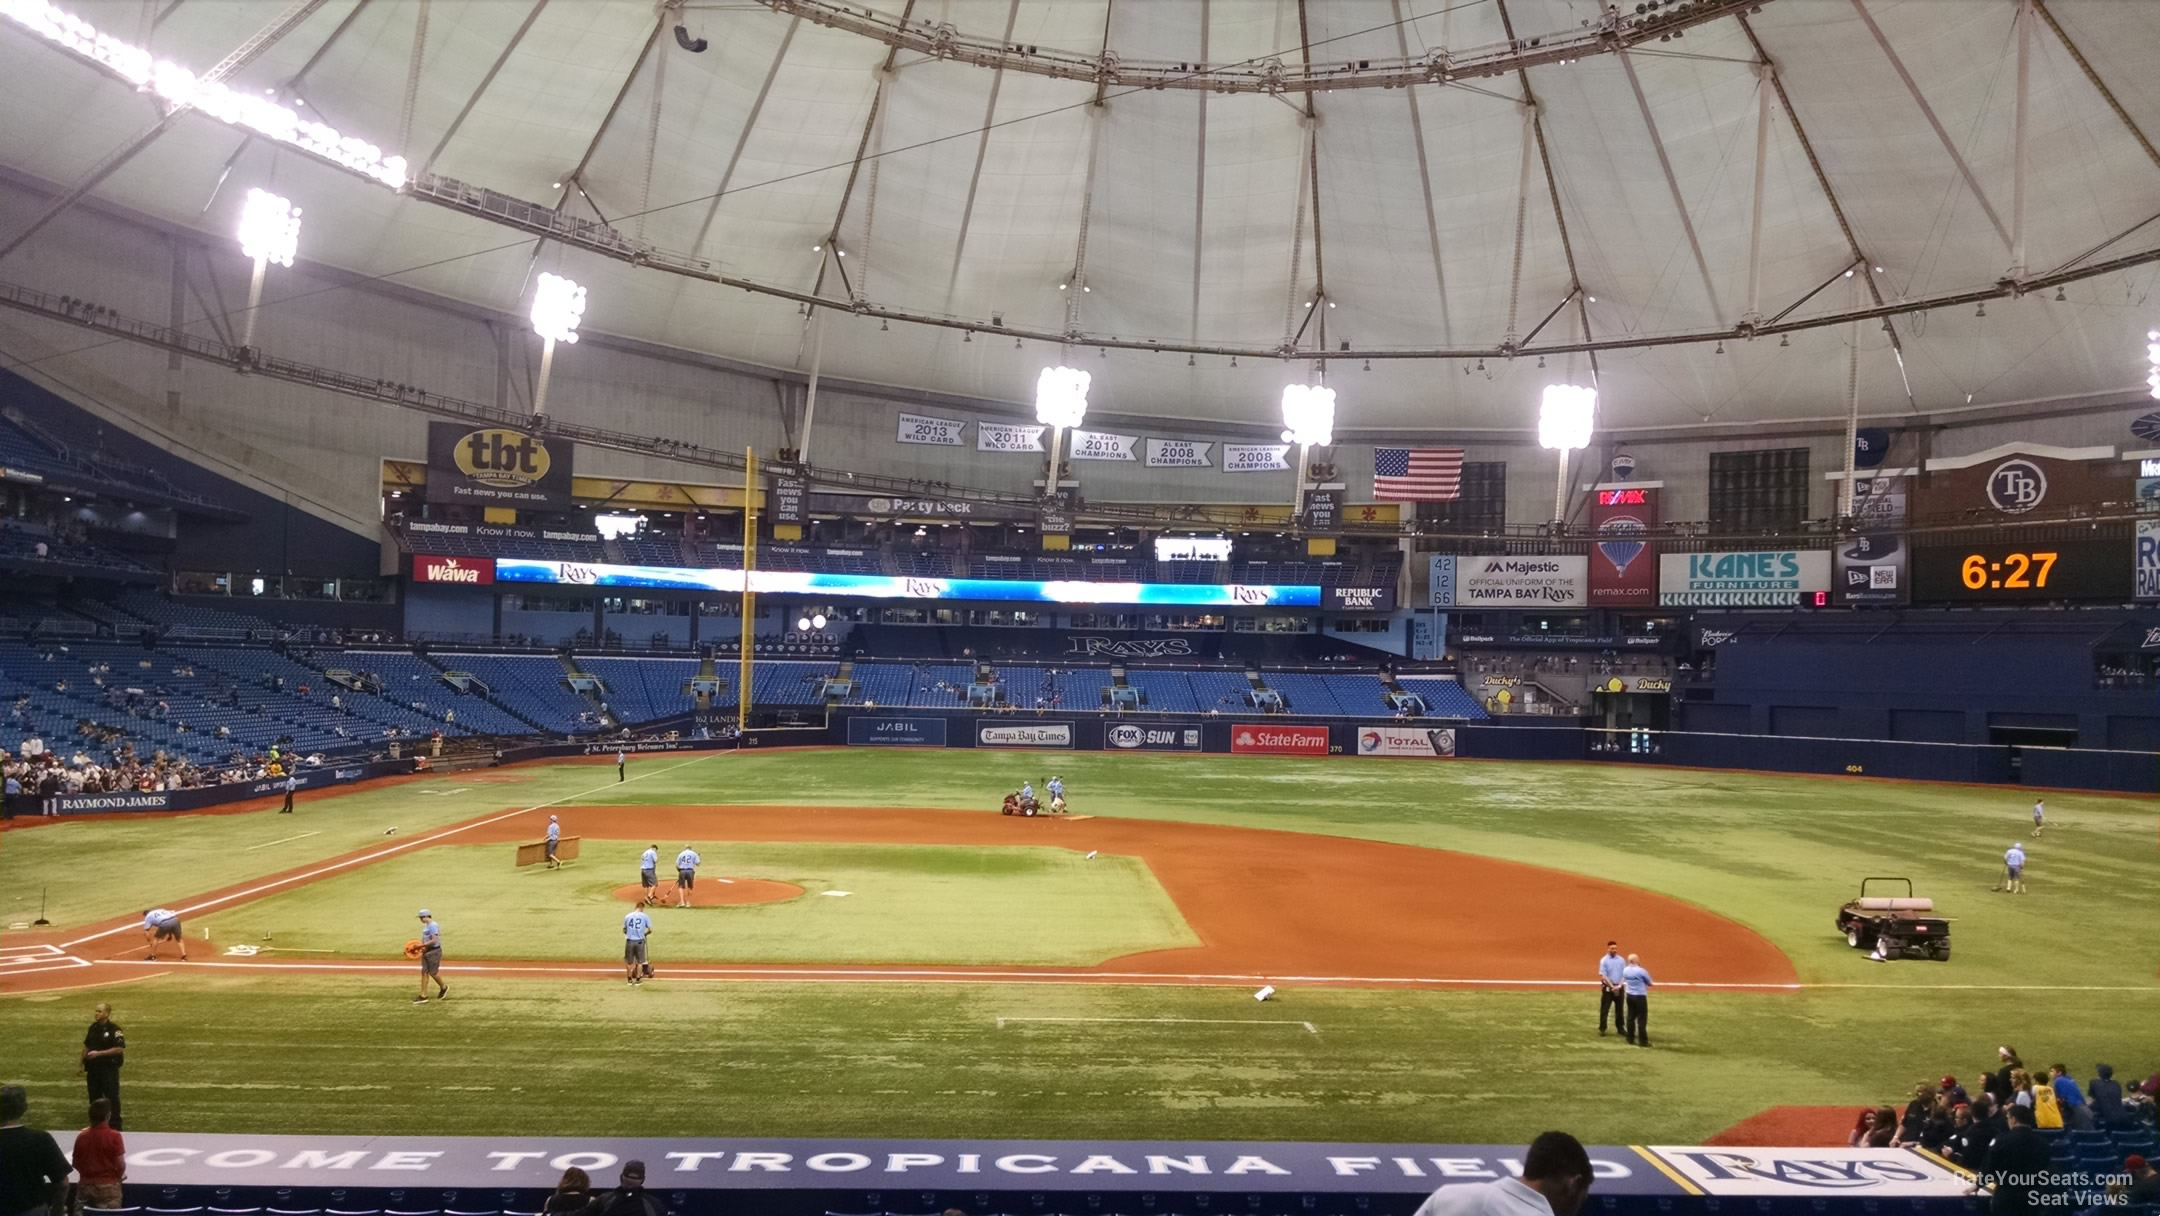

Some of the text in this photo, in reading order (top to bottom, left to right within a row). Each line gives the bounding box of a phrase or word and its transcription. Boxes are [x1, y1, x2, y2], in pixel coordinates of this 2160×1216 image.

[901, 417, 934, 425] AMERICAN
[915, 424, 948, 437] 2013
[905, 433, 954, 444] WILD CARD
[994, 432, 1026, 443] 2011
[1010, 442, 1034, 450] CARD
[1085, 440, 1120, 452] 2010
[1856, 437, 1869, 451] TB
[467, 433, 538, 474] tbt
[1075, 450, 1128, 459] CHAMPIONS
[1161, 448, 1194, 458] 2008
[1238, 452, 1273, 463] 2008
[1150, 457, 1203, 466] CHAMPIONS
[1228, 462, 1281, 470] CHAMPIONS
[776, 487, 802, 496] news
[1998, 470, 2037, 503] TB
[454, 486, 472, 495] Fast
[530, 493, 548, 501] use.
[780, 495, 799, 505] you
[780, 503, 798, 512] can
[779, 512, 799, 521] use.
[410, 522, 597, 542] tampabay.com Know it now. tampabay.com
[1041, 522, 1070, 532] buzz?
[1859, 537, 1870, 551] TB
[827, 548, 863, 556] tampabay.com
[1434, 559, 1451, 571] 42
[1506, 561, 1560, 575] Majestic
[1690, 553, 1799, 579] KANE'S
[427, 563, 477, 582] Wawa
[1962, 553, 2058, 589] 6:27
[1437, 575, 1449, 588] 12
[1693, 581, 1793, 590] FURNITURE
[1335, 588, 1382, 598] REPUBLIC
[1469, 589, 1512, 599] TAMPA
[1515, 589, 1540, 599] BAY
[1593, 587, 1649, 596] remax.com
[1345, 597, 1372, 606] BANK
[1434, 592, 1451, 604] 66
[1068, 636, 1193, 658] RAYS
[1638, 678, 1671, 691] Ducky
[695, 715, 708, 723] 162
[877, 722, 918, 732] JABIL
[985, 730, 1066, 742] Tampa Bay Times
[1117, 730, 1138, 738] FOX
[1147, 730, 1175, 744] SUN
[1387, 737, 1428, 746] TOTAL
[602, 743, 636, 752] Petersburg
[1330, 745, 1343, 753] 370
[1846, 765, 1863, 773] 404
[62, 796, 166, 809] RAYMOND JAMES
[681, 855, 692, 864] 42
[628, 918, 642, 929] 42
[488, 1151, 619, 1172] TO
[665, 1151, 1292, 1175] TROPICANA
